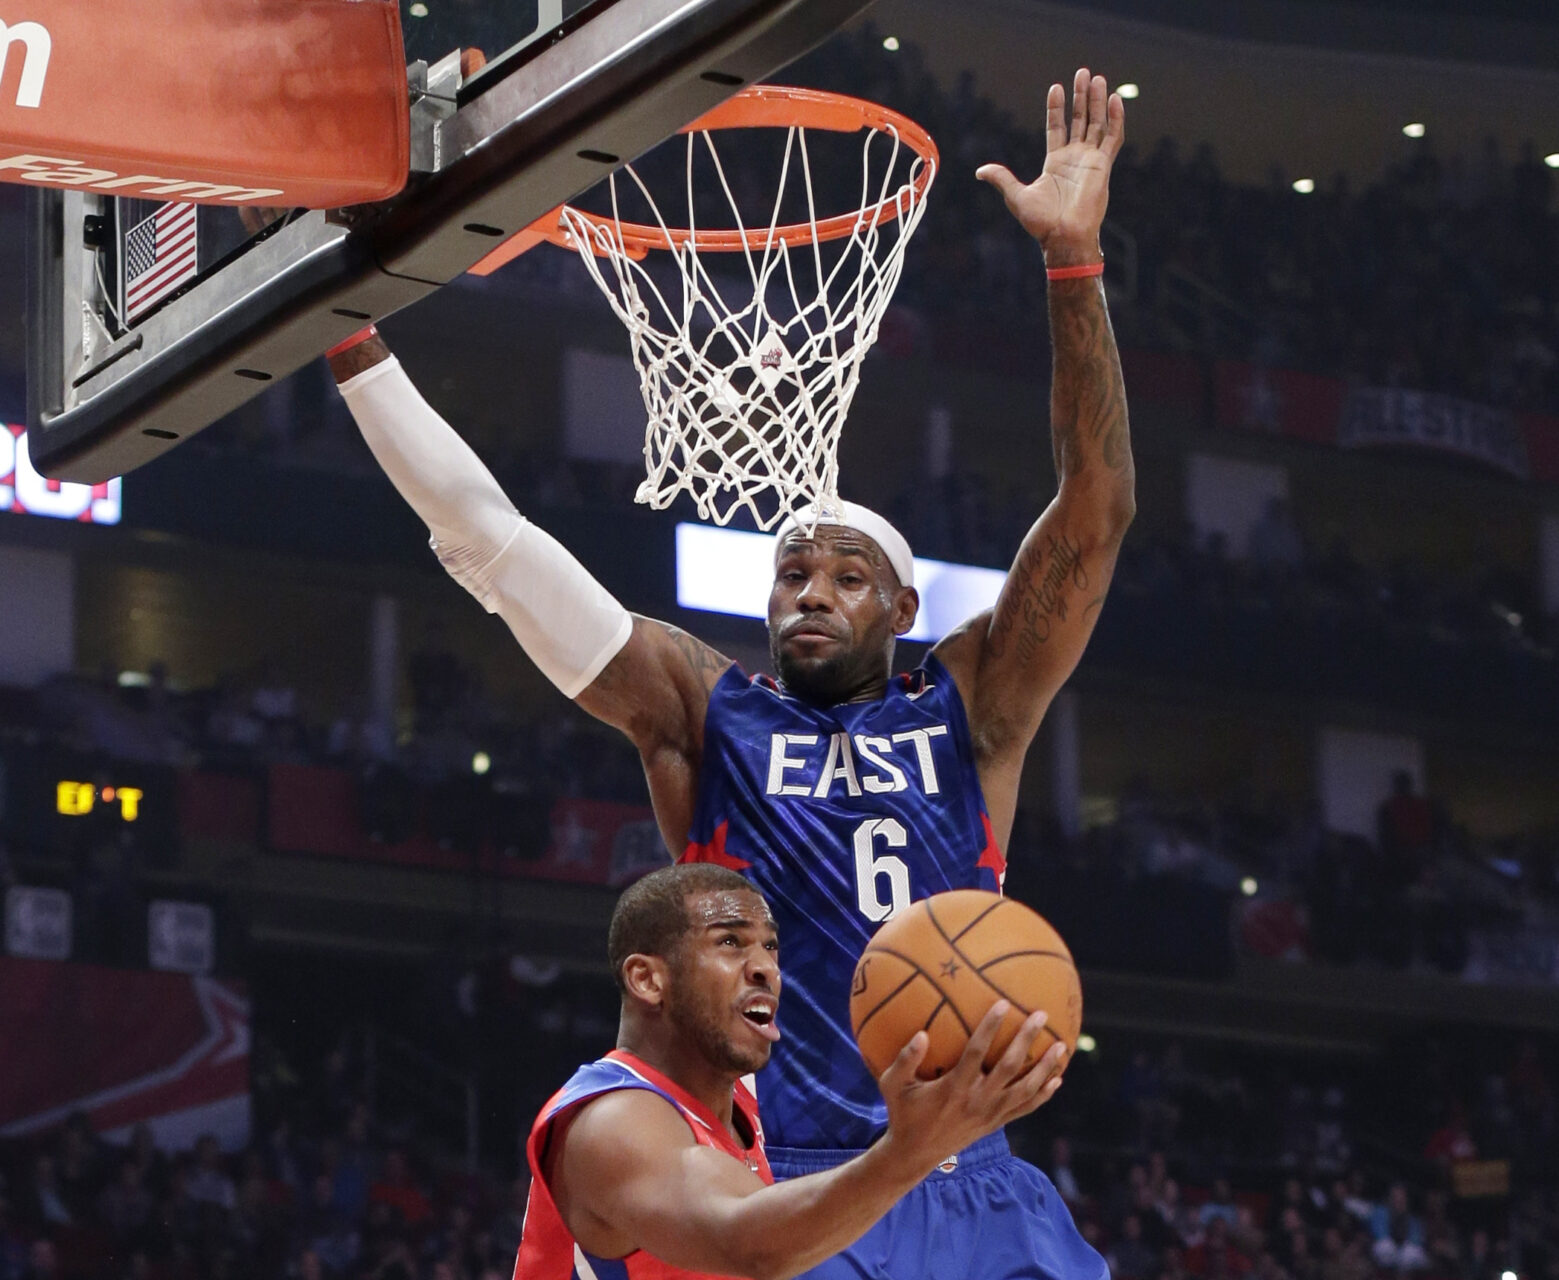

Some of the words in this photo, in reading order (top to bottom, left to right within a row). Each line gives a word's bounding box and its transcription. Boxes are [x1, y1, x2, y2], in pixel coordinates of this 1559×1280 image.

[0, 154, 284, 201] Farm
[765, 724, 948, 799] EAST
[853, 817, 911, 923] 6
